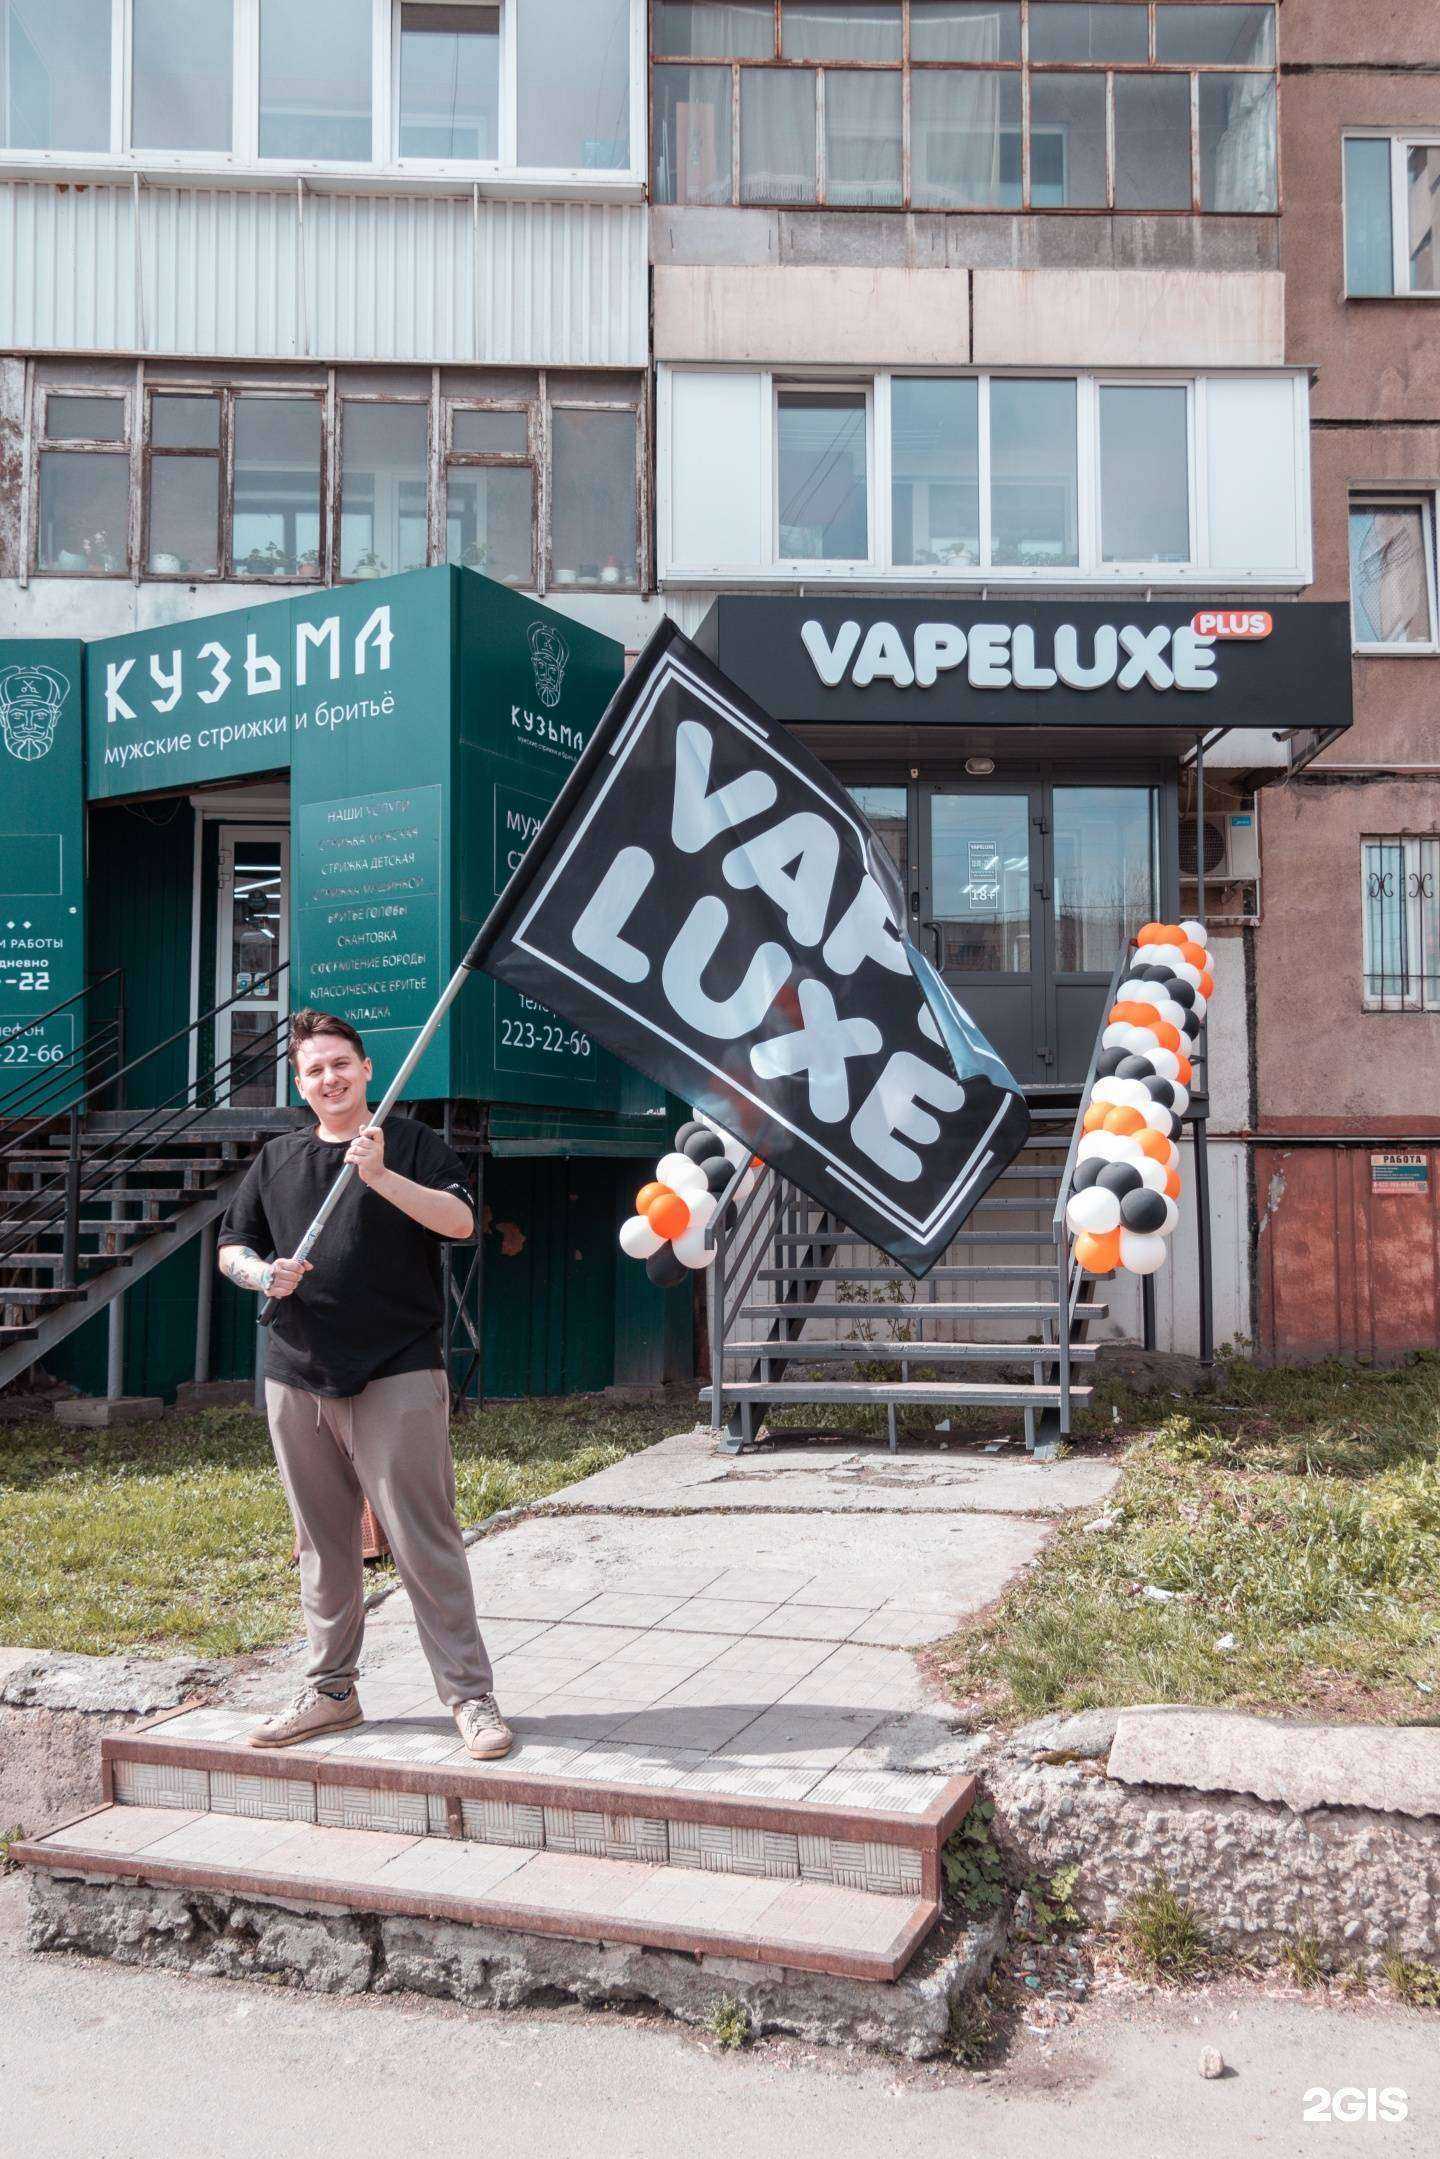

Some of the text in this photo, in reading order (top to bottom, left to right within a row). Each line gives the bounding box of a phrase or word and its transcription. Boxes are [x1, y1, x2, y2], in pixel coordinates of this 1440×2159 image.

[1199, 613, 1266, 635] PLUS
[104, 605, 394, 723] КУЗЬМА
[800, 620, 1219, 691] VAPELUXE
[104, 691, 395, 768] мужские стрижки и бритьё
[511, 704, 583, 751] КУЗЬМА
[327, 807, 363, 823] НАШИ
[321, 852, 415, 875] СТРИЖКА ДЕТСКАЯ
[671, 720, 944, 1048] VAP
[971, 888, 995, 901] 18+
[11, 938, 63, 949] РАБОТЫ
[0, 959, 49, 969] дневно
[383, 953, 426, 969] БОРОДЫ
[0, 971, 50, 991] -22
[345, 1006, 391, 1020] УКЛАДКА
[571, 846, 965, 1183] LUXE
[501, 1019, 590, 1056] 223-22-66
[0, 1044, 63, 1063] 22-66
[1383, 1155, 1421, 1164] РАБОТА
